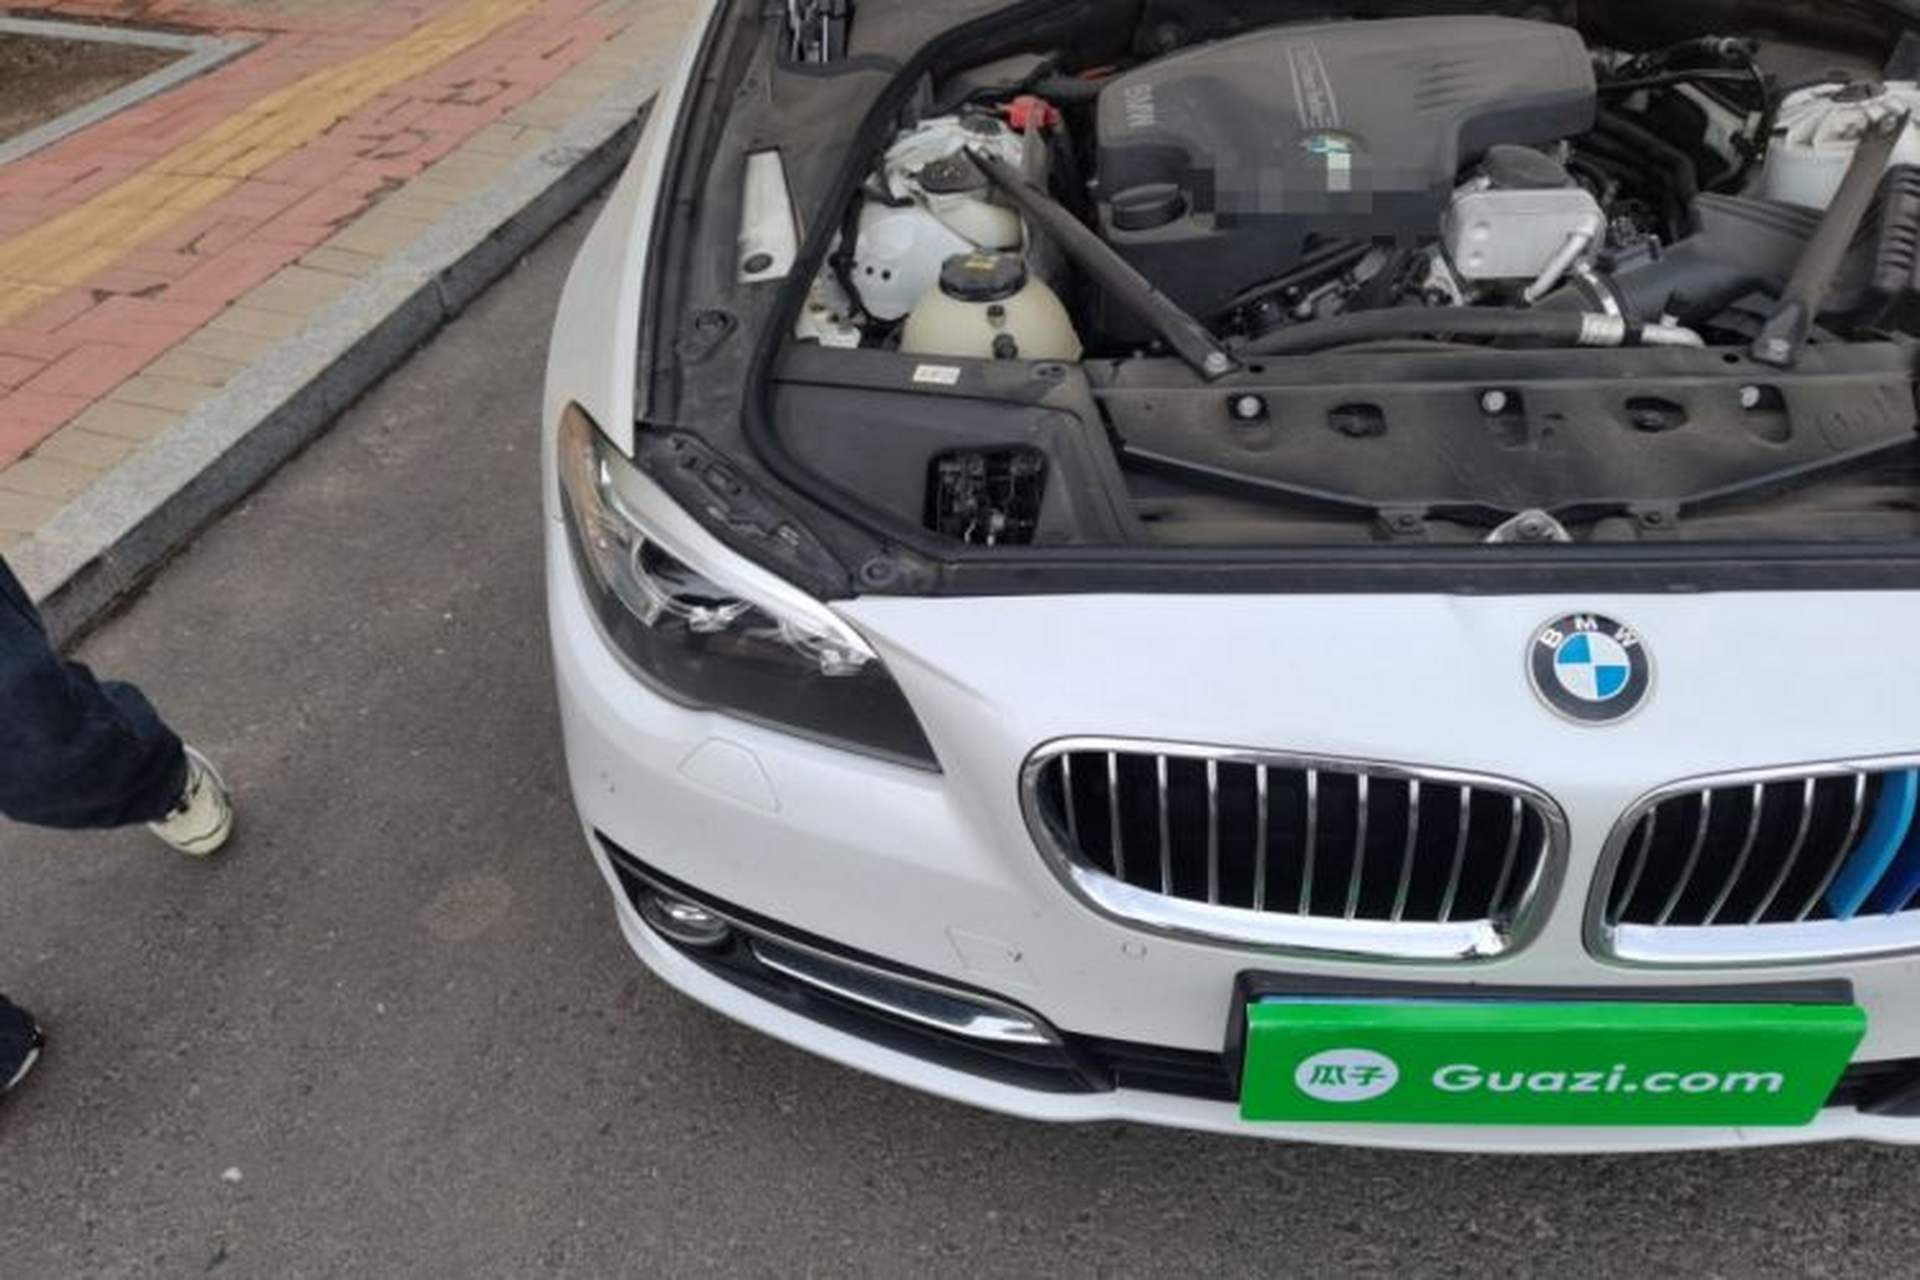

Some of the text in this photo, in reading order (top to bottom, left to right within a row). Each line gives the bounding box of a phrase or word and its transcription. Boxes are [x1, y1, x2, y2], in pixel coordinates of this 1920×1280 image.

[1540, 615, 1640, 648] BMW
[1308, 1064, 1387, 1087] 瓜子
[1432, 1063, 1784, 1093] Guazi.com
